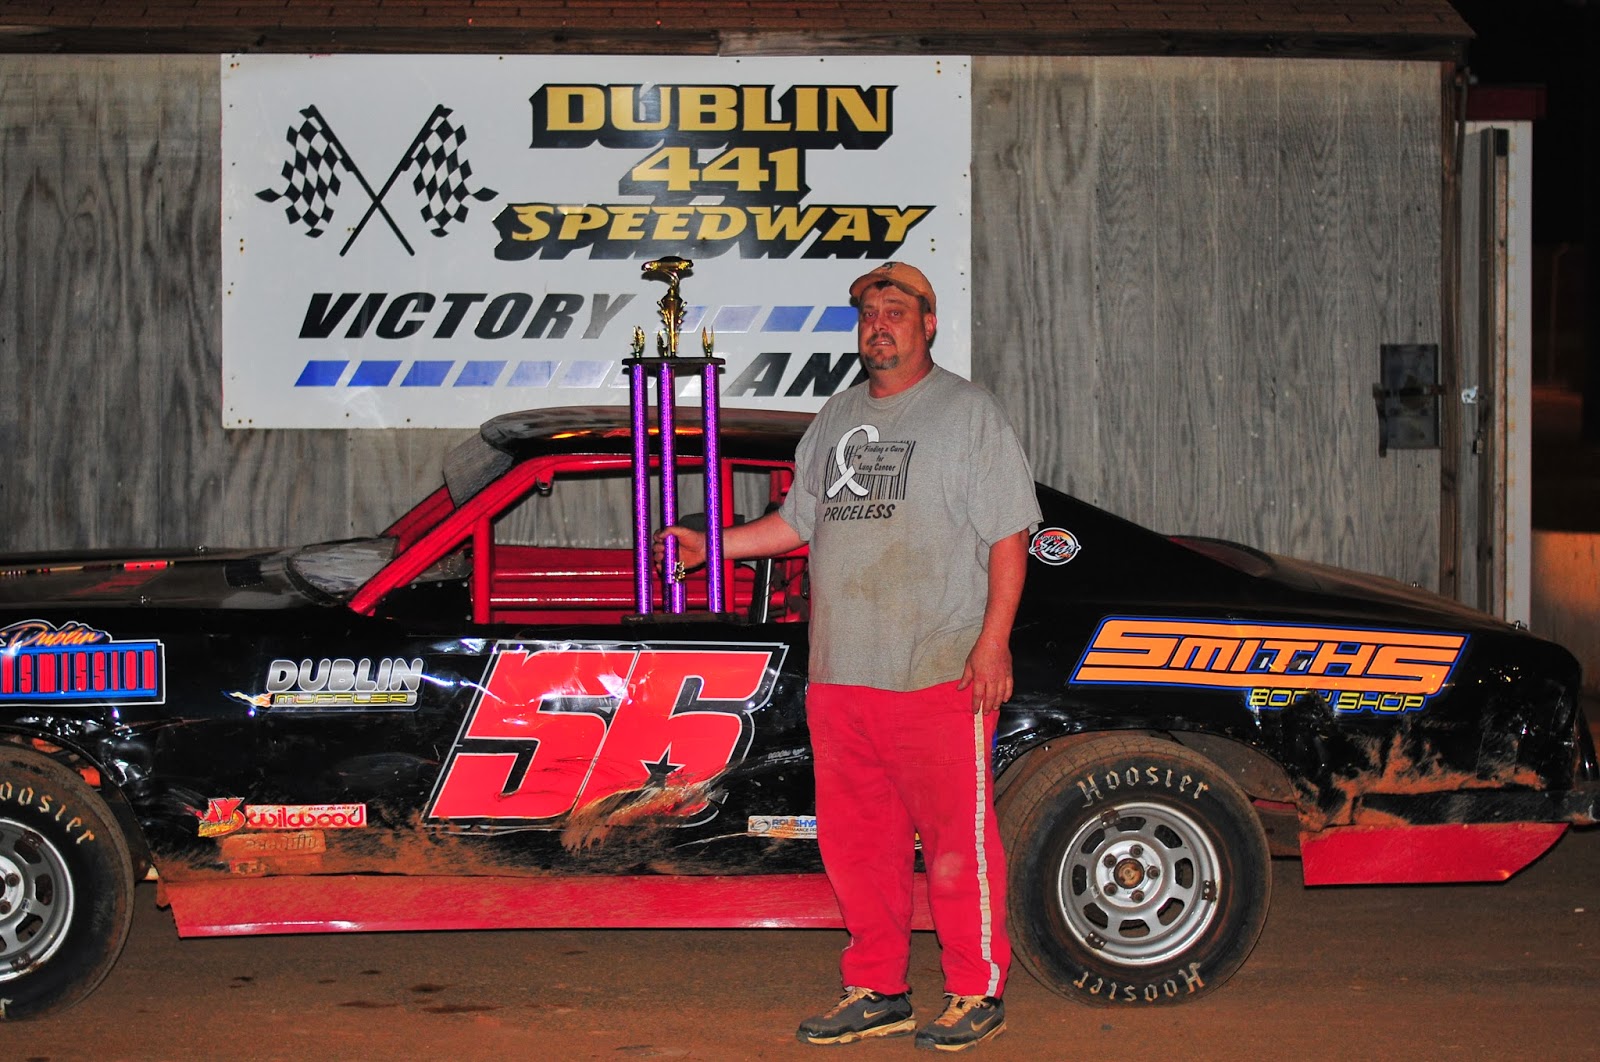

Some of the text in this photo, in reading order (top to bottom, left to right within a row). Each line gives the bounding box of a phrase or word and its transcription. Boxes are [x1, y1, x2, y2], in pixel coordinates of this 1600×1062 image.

[538, 85, 893, 142] DUBLIN
[627, 146, 804, 197] 441
[503, 205, 932, 249] SPEEDWAY
[297, 291, 638, 340] VICTORY
[858, 463, 873, 473] Lung
[863, 445, 884, 454] Finding
[889, 445, 905, 453] Cure
[823, 503, 896, 522] PRICELESS
[3, 623, 104, 647] Dublin
[266, 658, 424, 692] DUBLIN
[1074, 619, 1466, 695] SMITHS
[276, 693, 409, 704] MUFFLER
[1337, 692, 1425, 712] SHOP
[428, 649, 774, 820] 56
[1077, 766, 1210, 808] Hoosier
[248, 806, 365, 828] wilwood
[1073, 962, 1206, 1002] Hoosier
